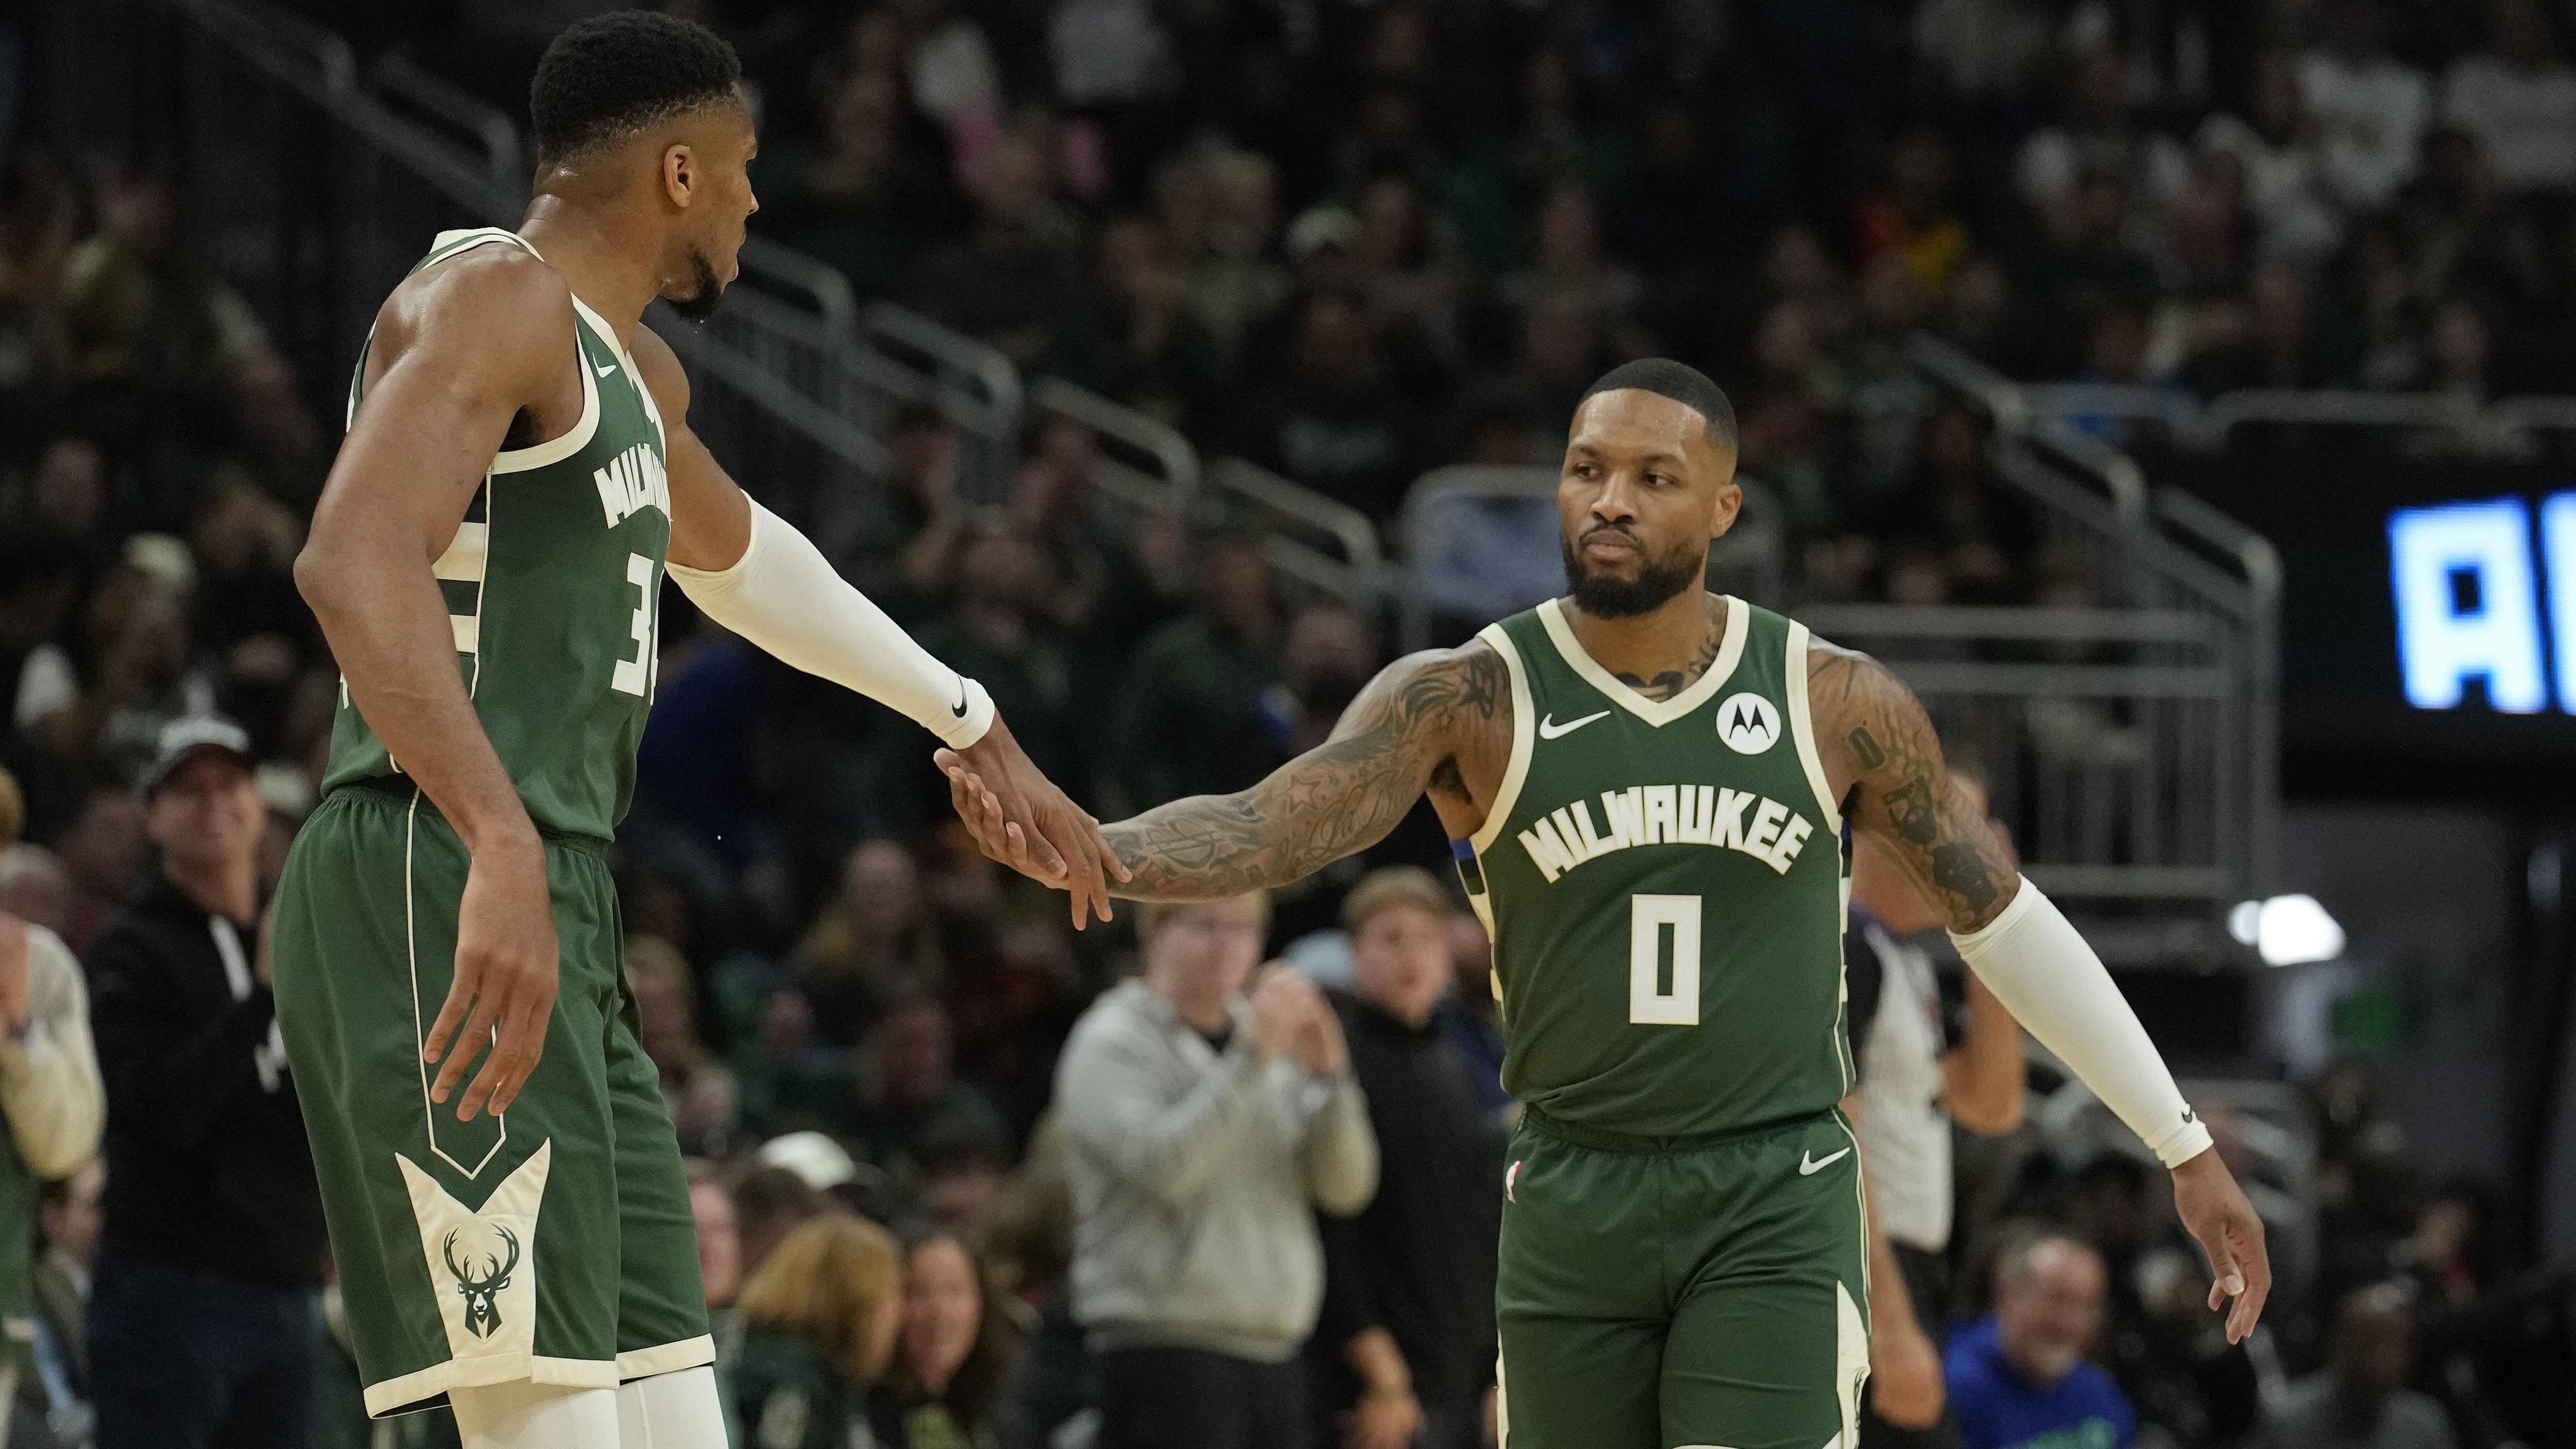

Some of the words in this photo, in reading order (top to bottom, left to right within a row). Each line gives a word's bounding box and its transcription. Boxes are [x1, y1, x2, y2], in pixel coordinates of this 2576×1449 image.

[611, 552, 659, 697] 3
[1517, 784, 1814, 884] MILWAUKEE
[1629, 894, 1702, 1026] 0
